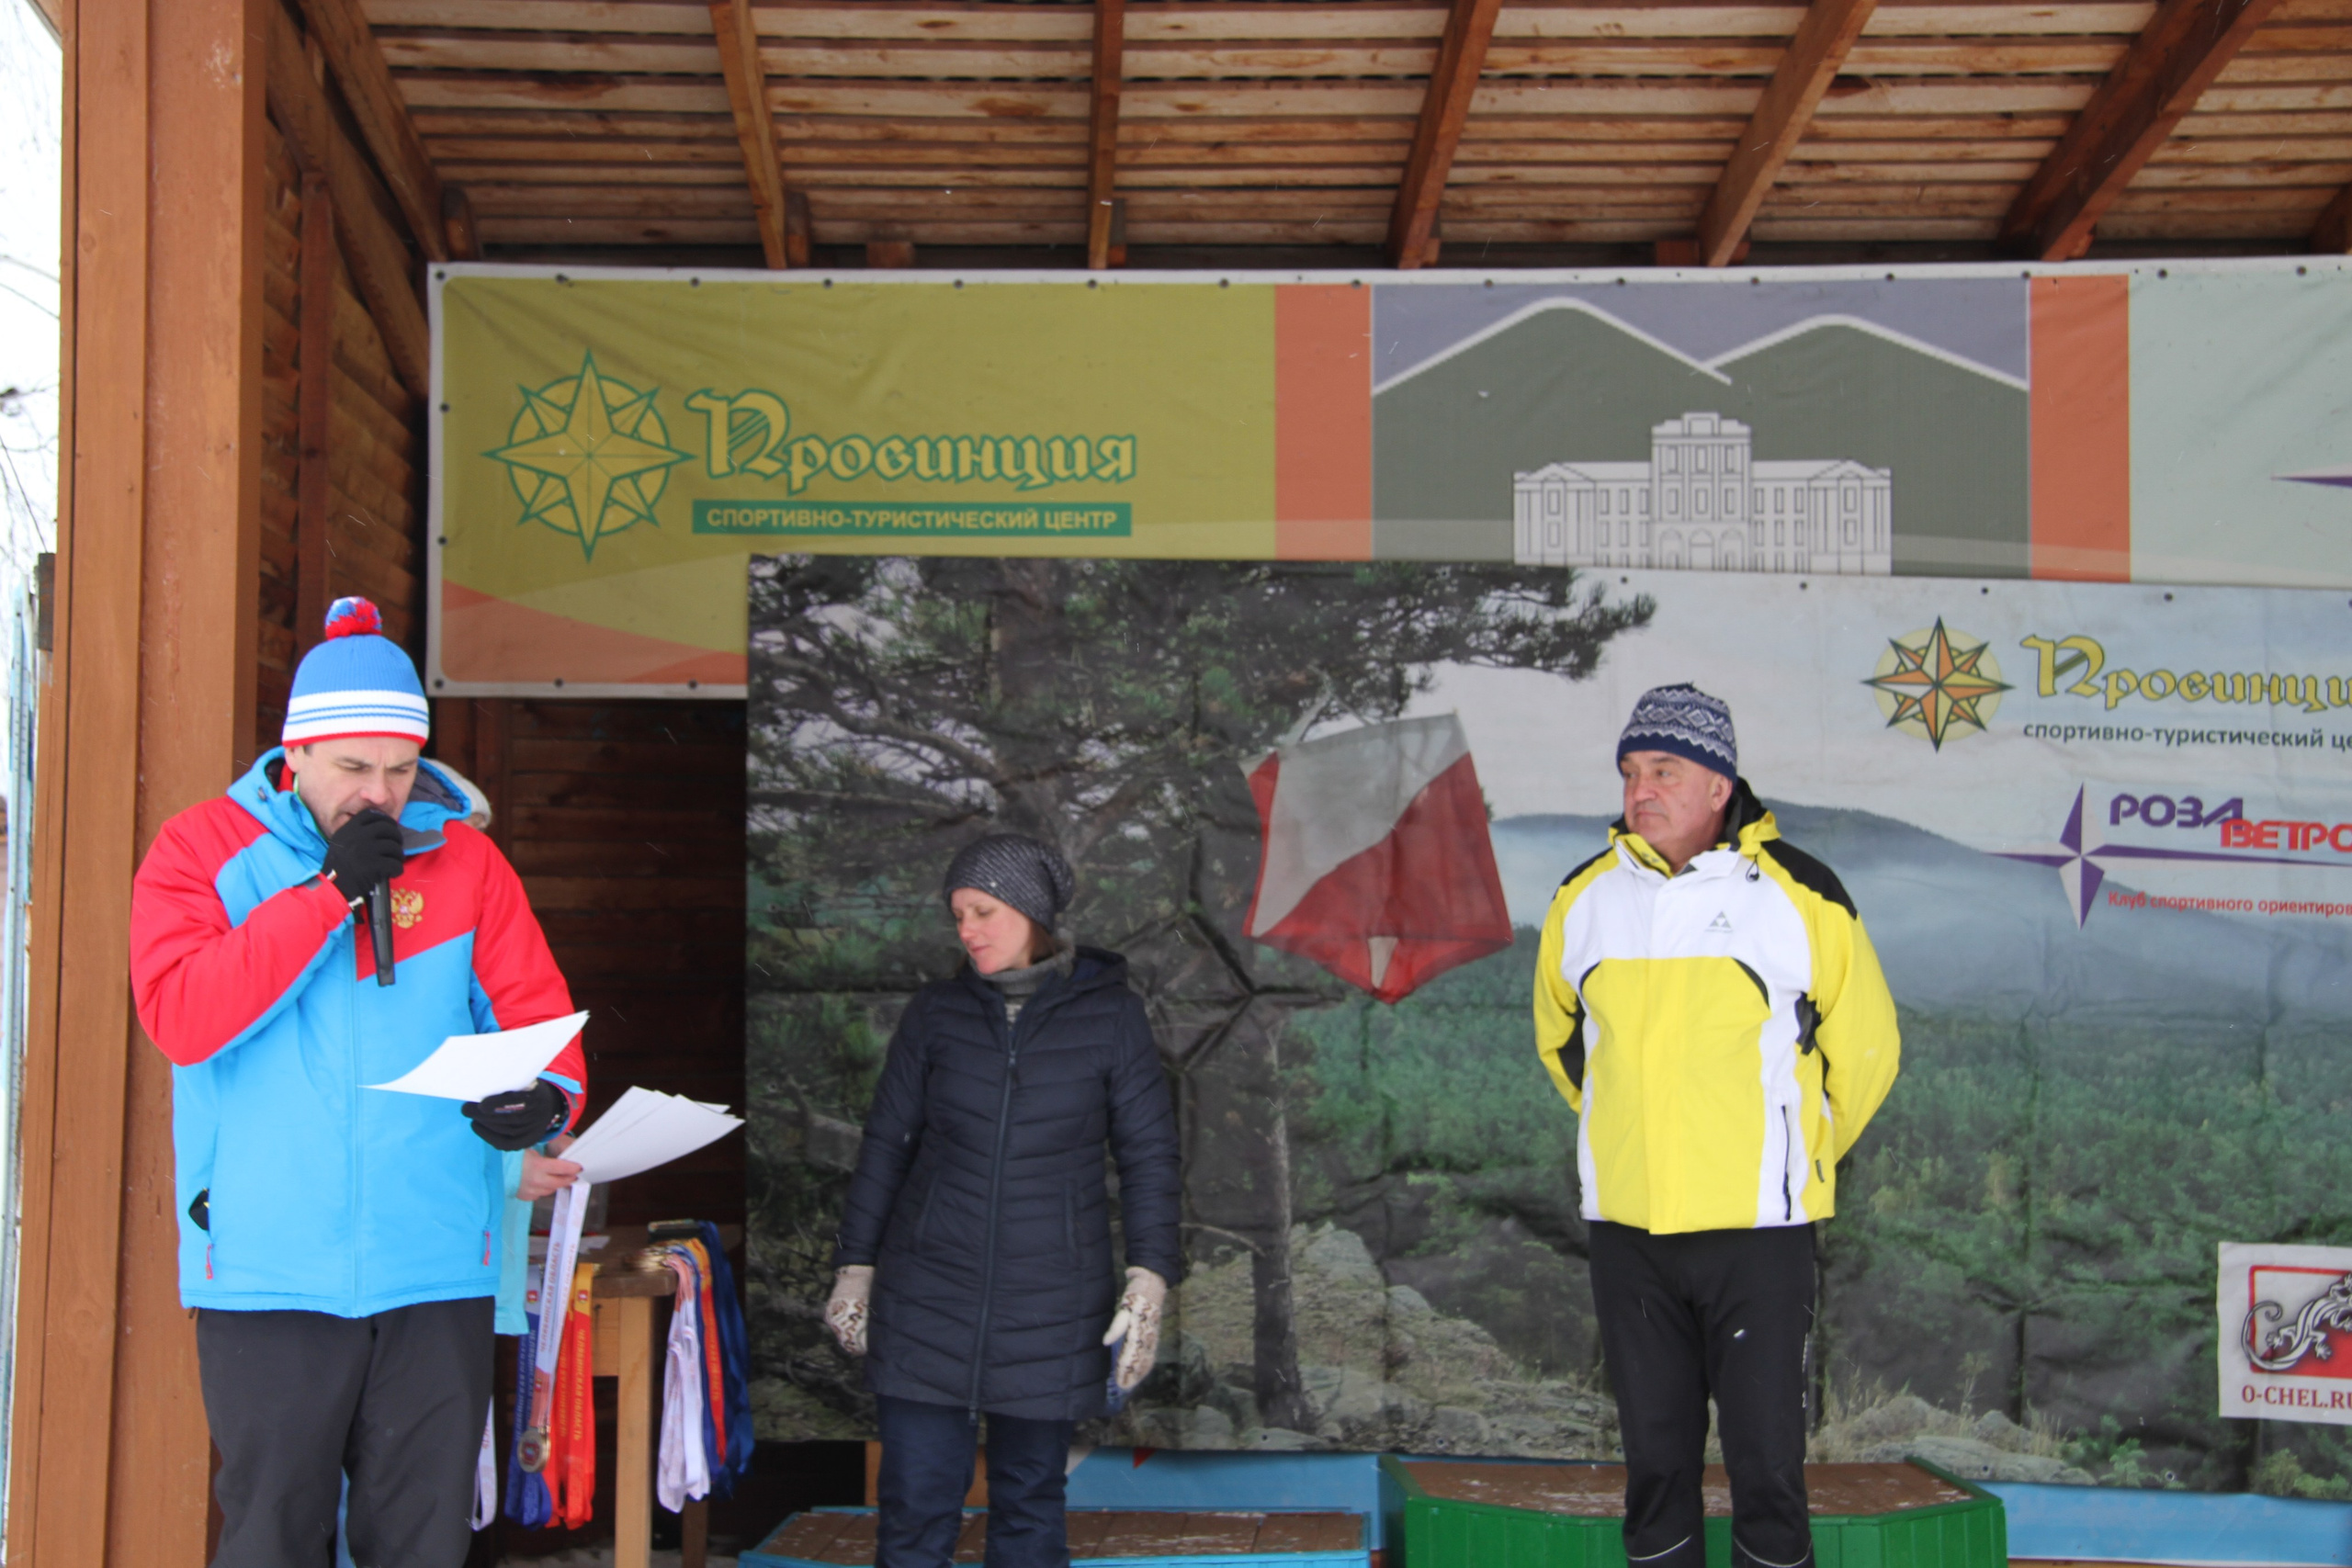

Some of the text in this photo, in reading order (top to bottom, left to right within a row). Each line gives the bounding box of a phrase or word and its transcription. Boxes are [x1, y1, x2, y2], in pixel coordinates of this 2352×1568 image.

[684, 388, 1136, 497] Провинция
[707, 507, 1117, 532] СПОРТИВНО-ТУРИСТИЧЕСКИЙ ЦЕНТР
[2023, 722, 2324, 747] спортивно-туристический
[2109, 794, 2243, 830] РОЗА
[2220, 818, 2352, 852] ВЕТРО
[2108, 891, 2352, 919] Клуб спортивного ориентиров
[540, 1242, 561, 1352] ЧЕЛЯБИНСКАЯ ОБЛАСТЬ
[573, 1329, 586, 1441] ЧЕЛЯБИНСКАЯ ОБЛАСТЬ
